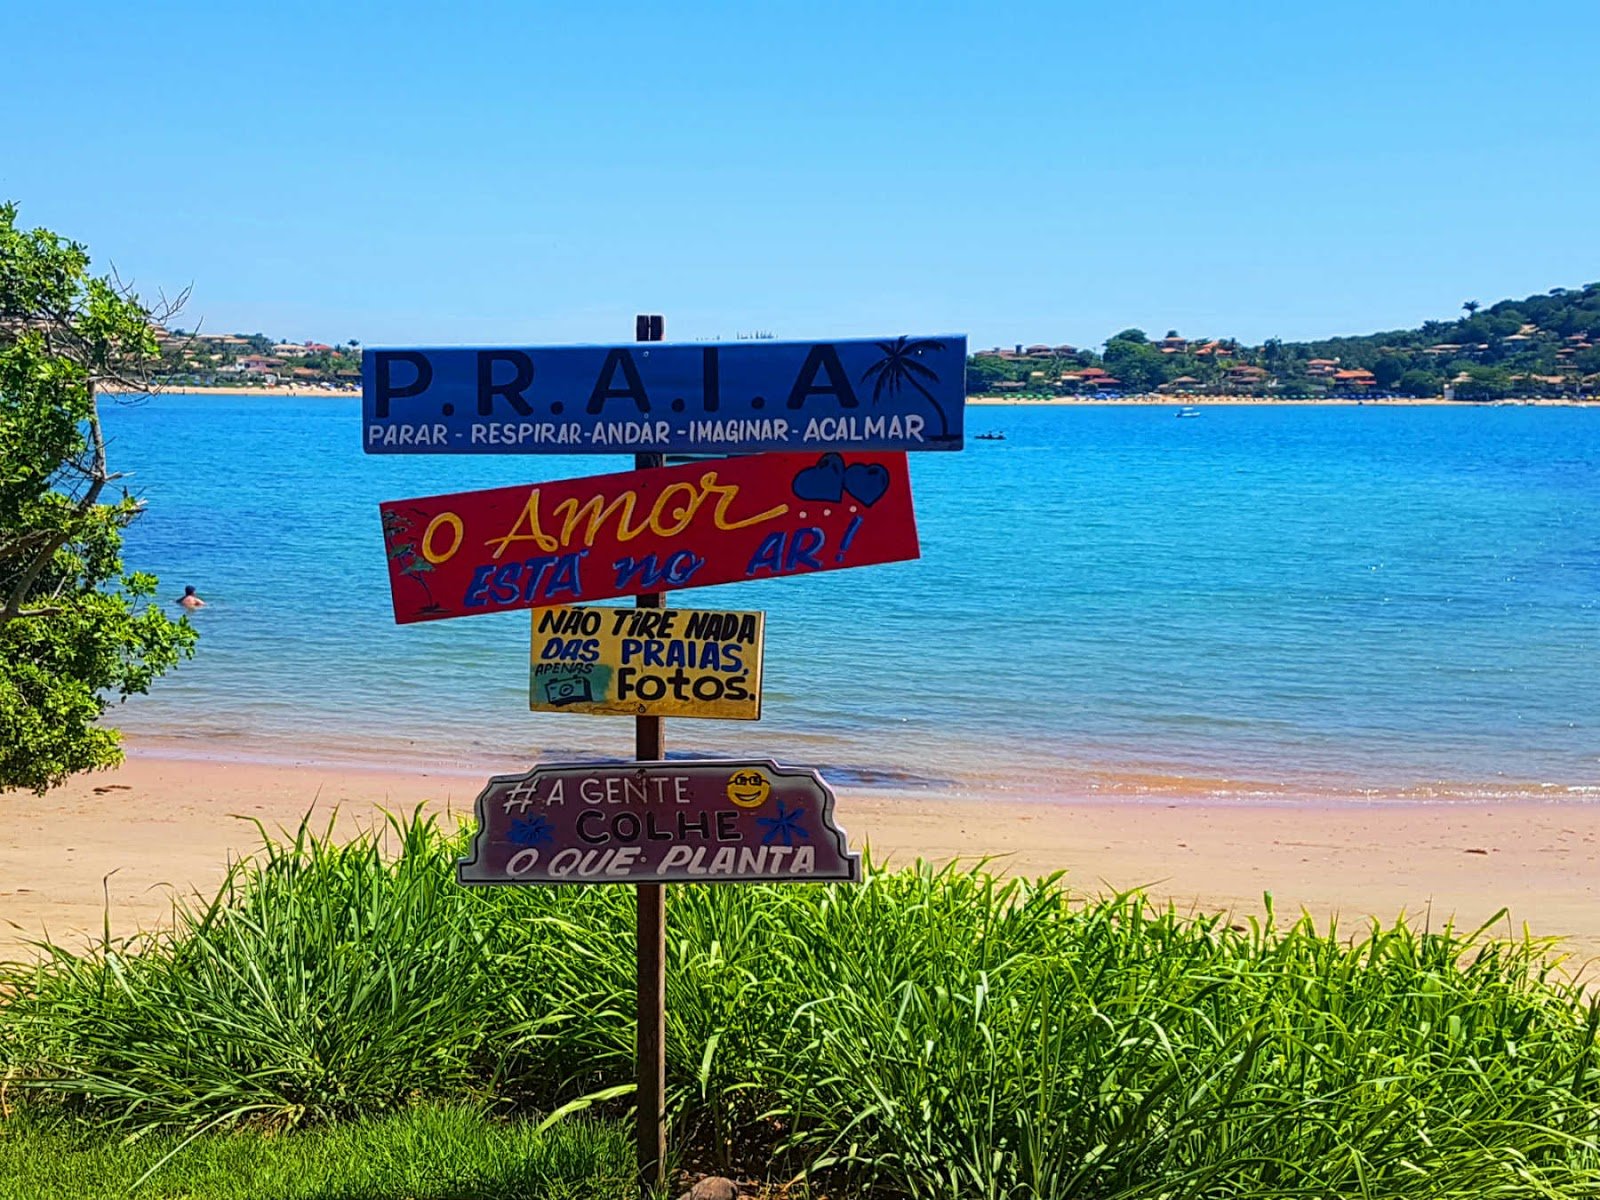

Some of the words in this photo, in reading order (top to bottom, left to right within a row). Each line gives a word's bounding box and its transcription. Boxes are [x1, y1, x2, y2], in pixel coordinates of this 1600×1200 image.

[369, 424, 448, 445] PARAR
[472, 422, 582, 444] RESPIRAR
[592, 420, 670, 444] ANDAR
[689, 419, 788, 443] IMAGINAR
[803, 415, 924, 442] ACALMAR
[422, 512, 464, 563] O
[538, 606, 601, 635] NÃO
[685, 612, 756, 644] NADA
[541, 638, 600, 662] DAS
[535, 663, 594, 676] APENAS
[580, 777, 691, 804] GENTE
[575, 810, 743, 843] COLHE
[506, 848, 540, 876] O
[657, 846, 815, 876] PLANTA
